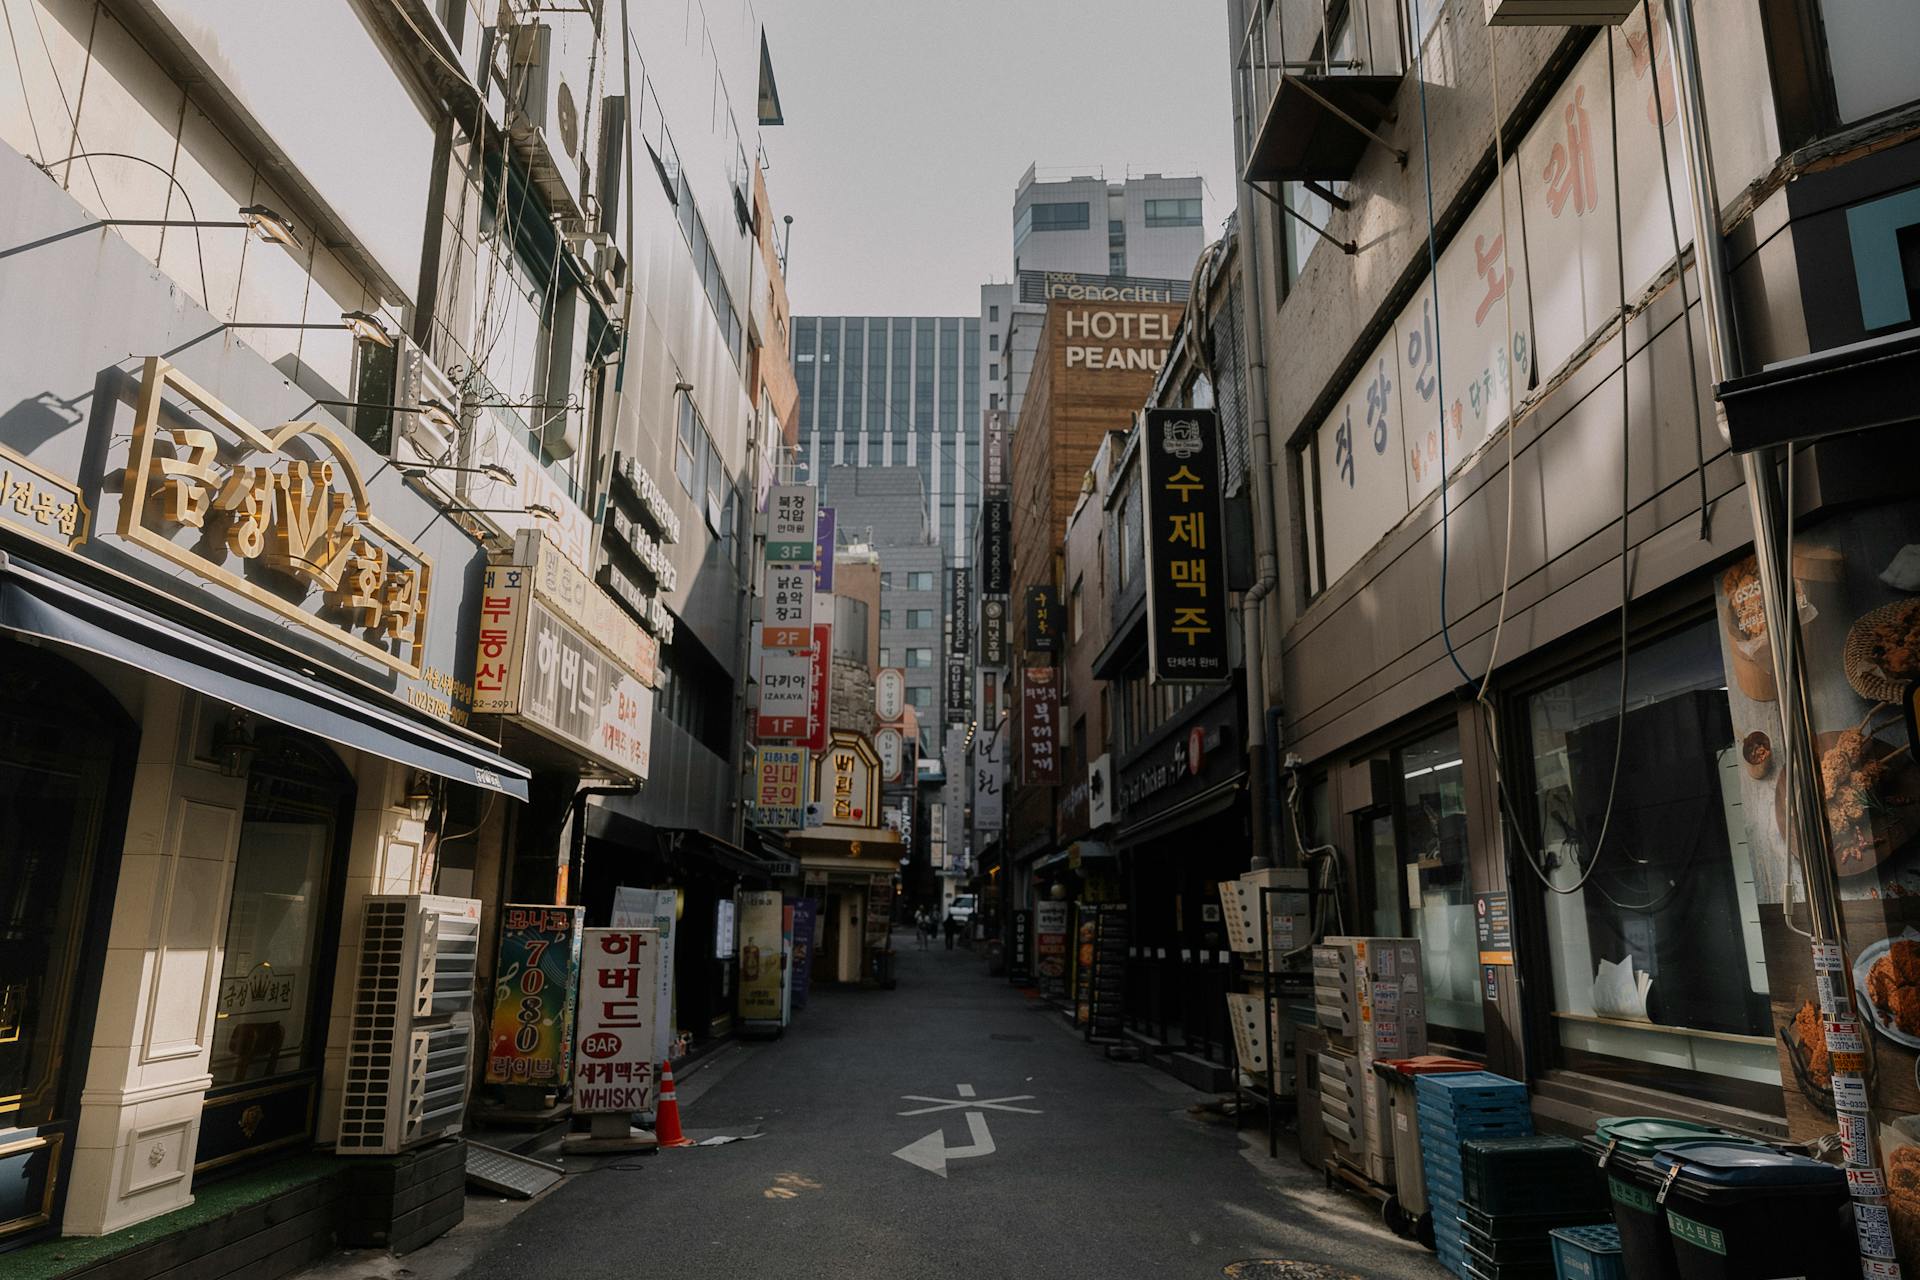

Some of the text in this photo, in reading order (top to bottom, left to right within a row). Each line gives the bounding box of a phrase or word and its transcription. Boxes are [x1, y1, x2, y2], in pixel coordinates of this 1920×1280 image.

[1066, 310, 1174, 340] HOTEL
[1335, 297, 1437, 489] 직장인
[778, 509, 805, 522] 지압
[150, 428, 274, 560] 금성
[350, 540, 421, 644] 회관
[780, 546, 802, 559] 3F
[1166, 465, 1211, 646] 수제맥주
[775, 608, 803, 621] 창고
[475, 595, 512, 692] 부동산
[777, 632, 800, 645] 2F
[537, 626, 598, 717] 하버드
[764, 692, 803, 701] IZAKAYA
[771, 719, 794, 733] 1F
[1030, 702, 1054, 772] 부대찌개
[763, 764, 798, 783] 임대
[761, 786, 796, 805] 문의
[597, 933, 647, 1029] 하버드
[514, 939, 550, 1053] 7080
[586, 1038, 617, 1052] BAR
[491, 1056, 556, 1080] 라이브
[579, 1087, 649, 1109] WHISKY
[1847, 1170, 1876, 1184] 카드
